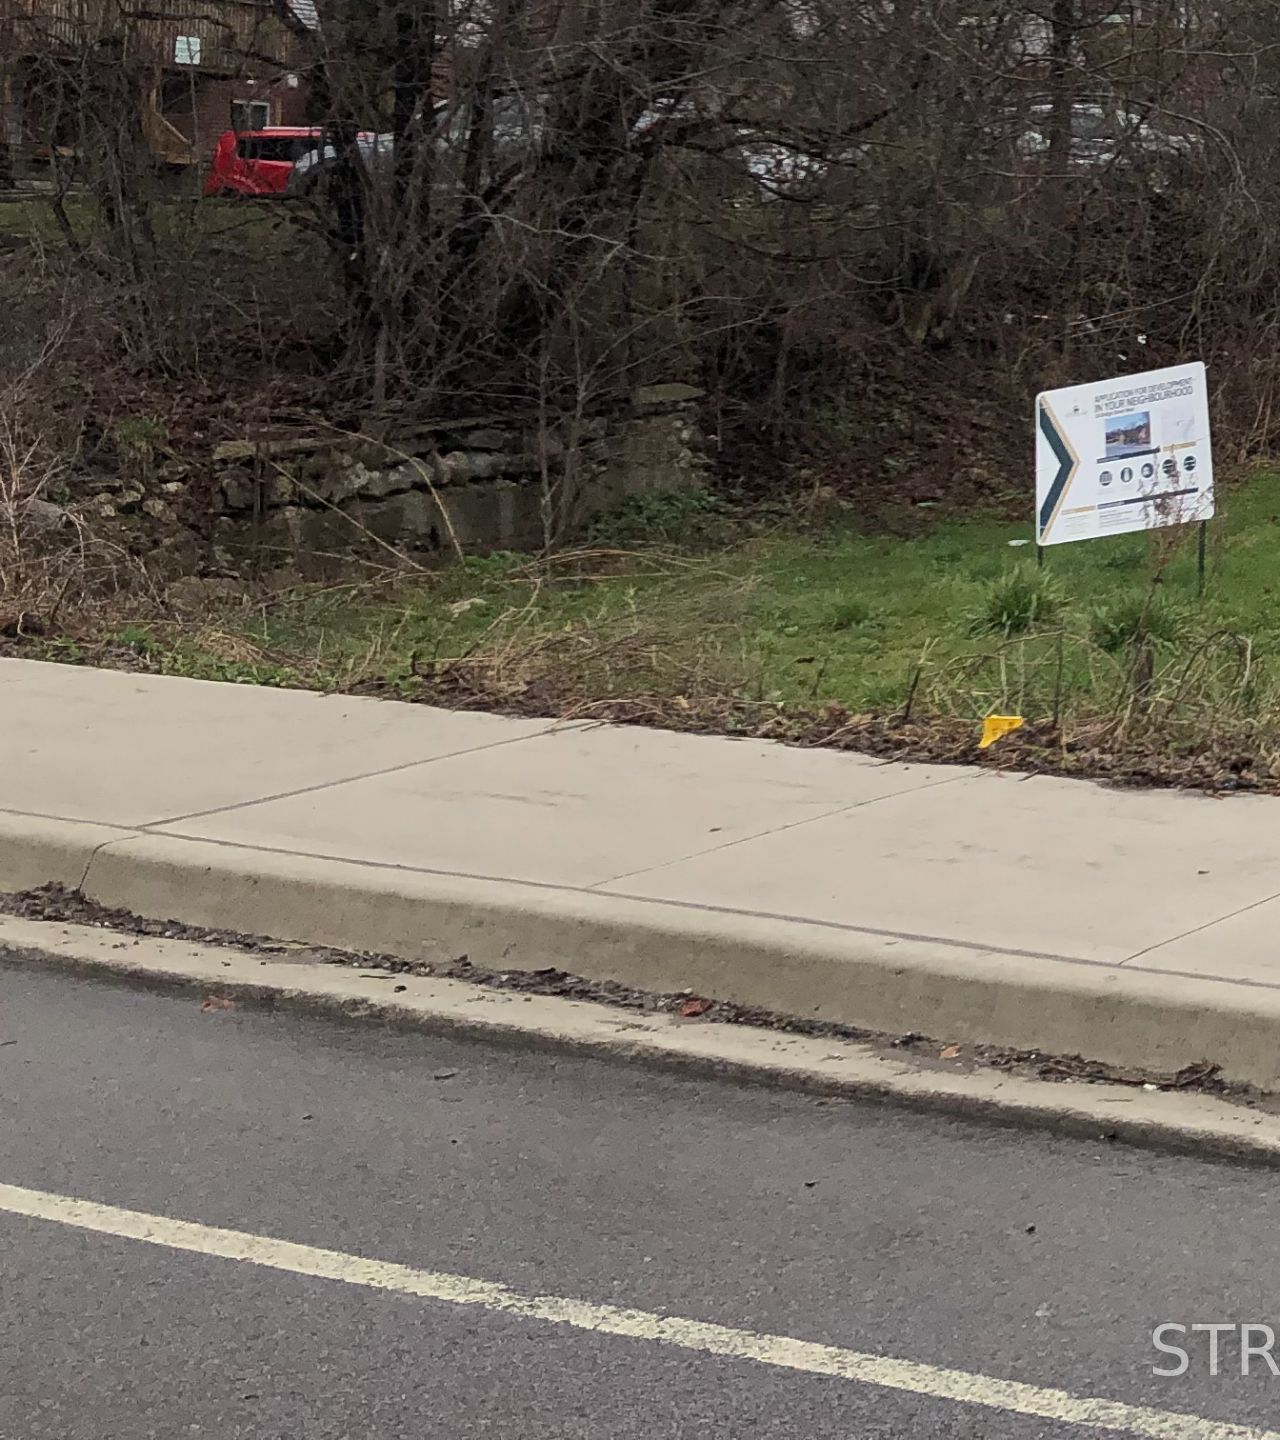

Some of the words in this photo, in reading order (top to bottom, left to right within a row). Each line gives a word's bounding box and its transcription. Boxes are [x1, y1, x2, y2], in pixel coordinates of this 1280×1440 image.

[1104, 399, 1125, 410] YOUR
[1127, 386, 1194, 406] NEIGHBOURHOOD
[1135, 386, 1147, 395] FOR
